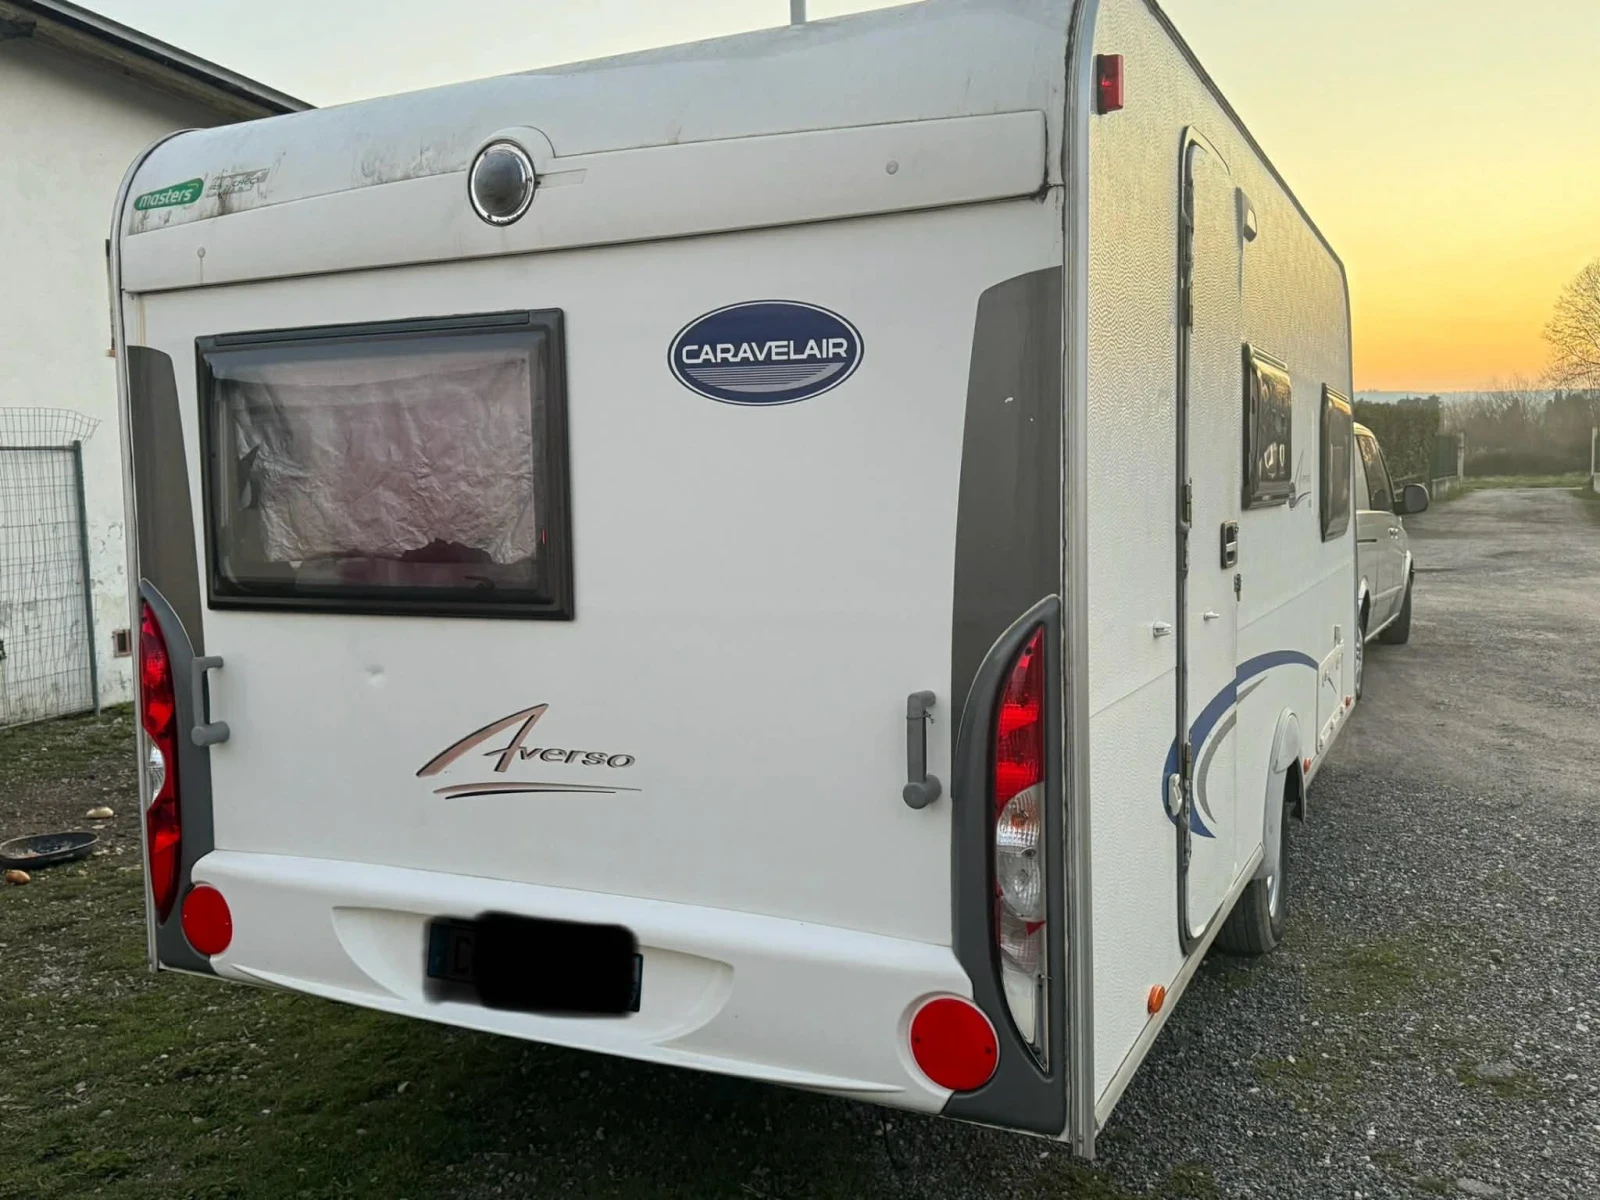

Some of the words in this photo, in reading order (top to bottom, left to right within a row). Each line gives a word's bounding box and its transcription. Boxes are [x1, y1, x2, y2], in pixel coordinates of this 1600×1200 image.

[138, 188, 194, 208] masters
[681, 338, 847, 363] CARAVELAIR
[415, 702, 636, 778] Averso
